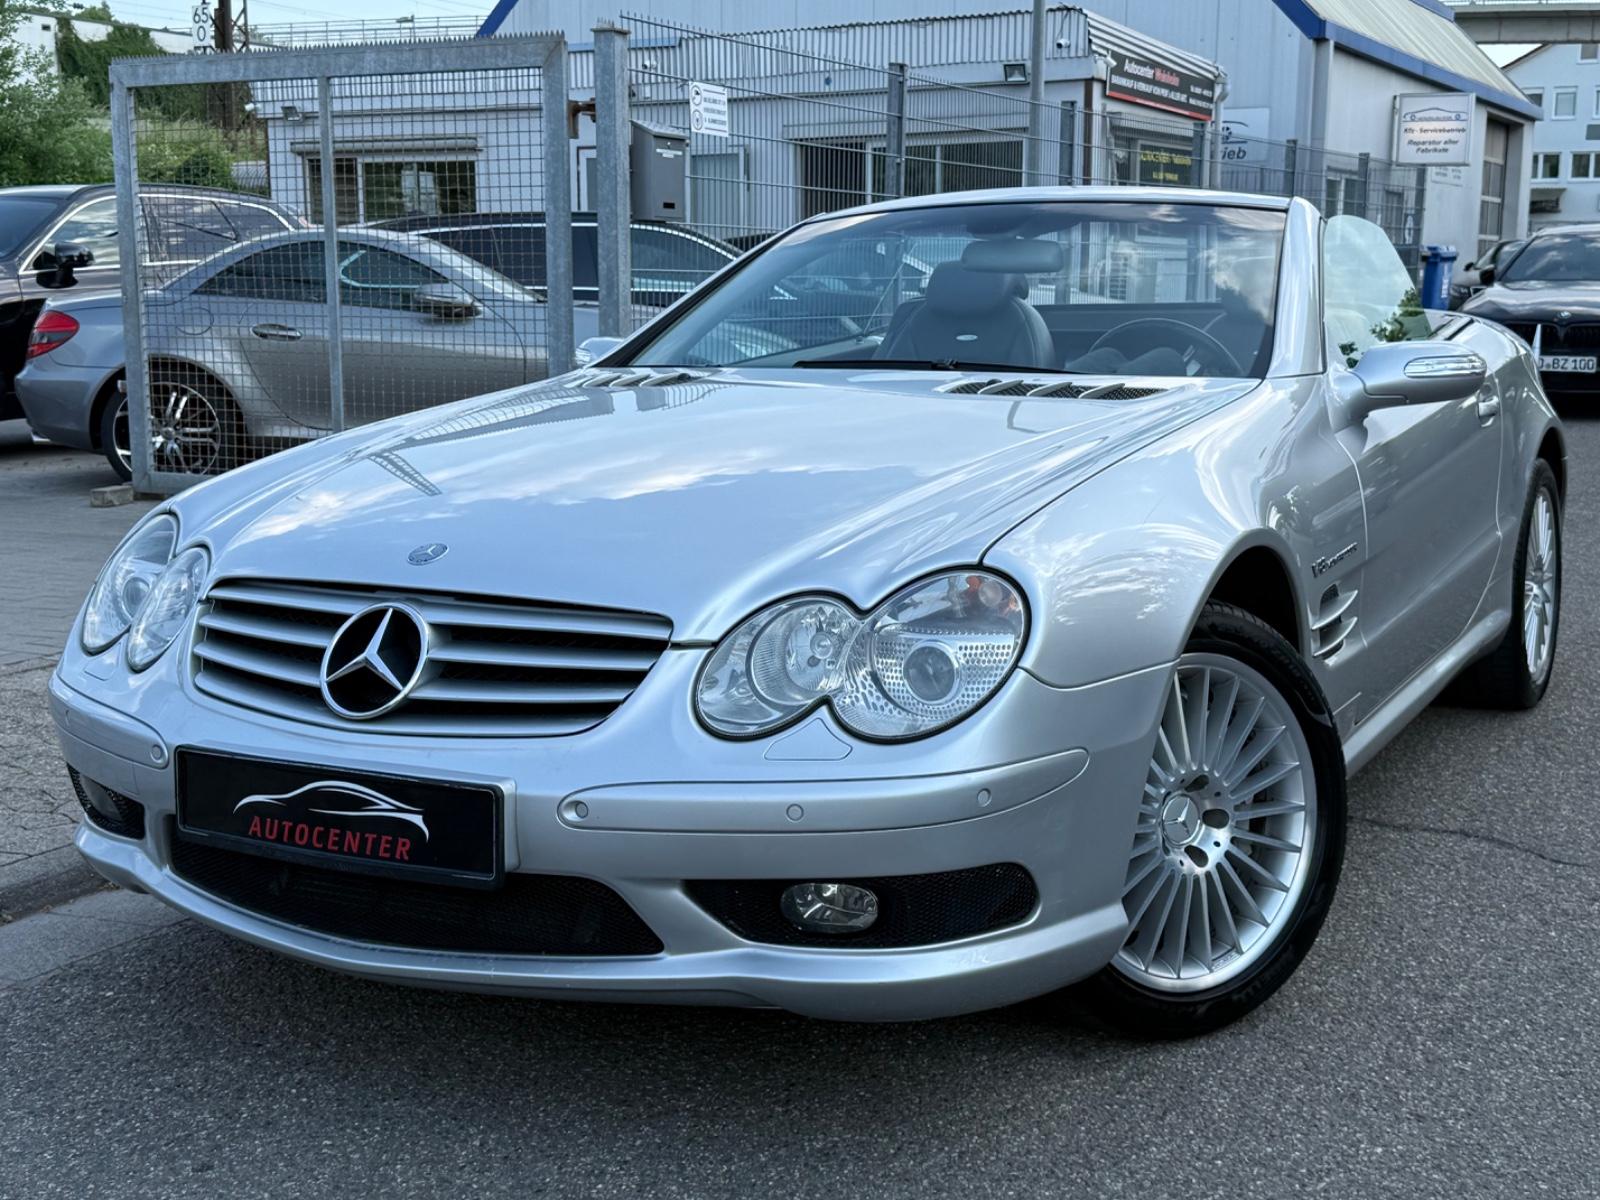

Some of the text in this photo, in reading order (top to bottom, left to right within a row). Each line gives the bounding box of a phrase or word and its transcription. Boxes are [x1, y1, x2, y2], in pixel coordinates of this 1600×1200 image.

[193, 7, 209, 24] 65
[197, 25, 206, 42] 0
[1221, 146, 1247, 160] ieb
[1552, 357, 1569, 370] BZ
[1571, 358, 1595, 371] 100
[248, 815, 412, 862] AUTOCENTER
